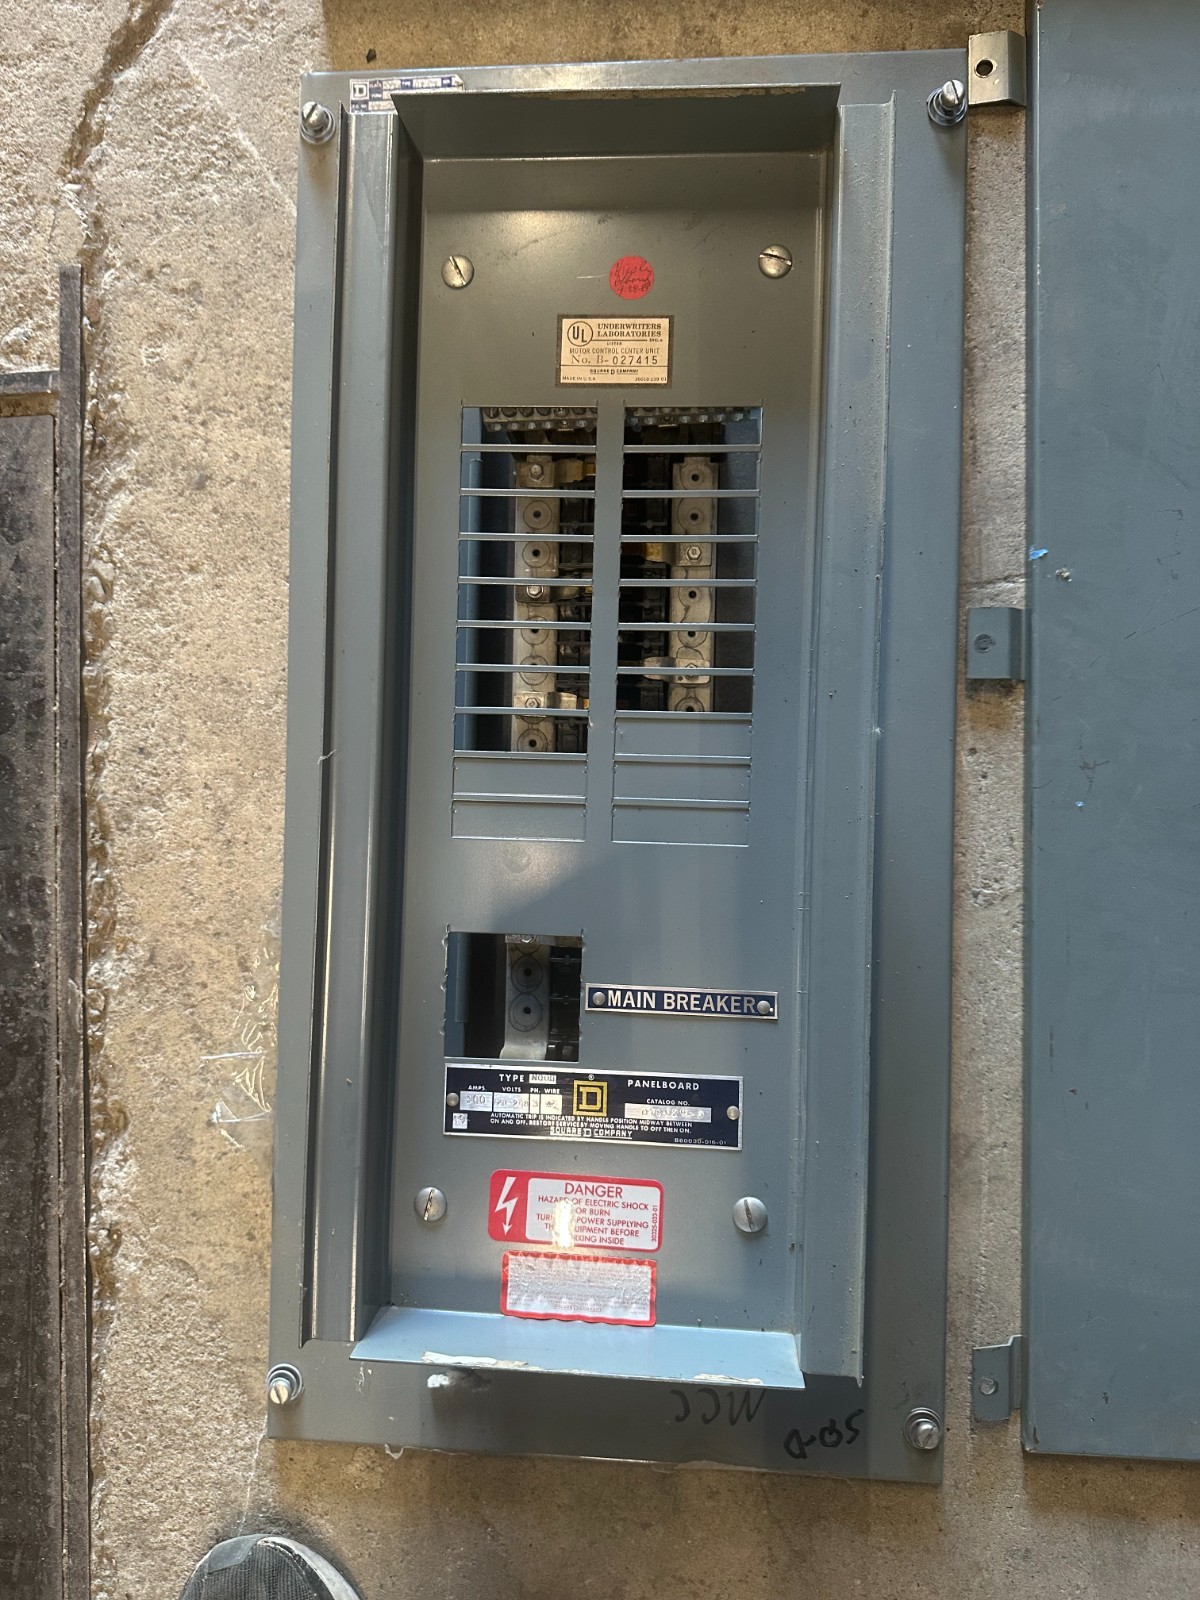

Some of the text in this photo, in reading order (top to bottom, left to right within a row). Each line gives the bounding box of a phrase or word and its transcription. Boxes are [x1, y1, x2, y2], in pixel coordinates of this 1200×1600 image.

[572, 326, 588, 342] UL
[571, 355, 591, 364] No.
[608, 990, 756, 1014] MAIN BREAKER
[499, 1074, 525, 1082] TYPE
[627, 1079, 700, 1091] PANELBOARD
[550, 1127, 632, 1138] SQUARE D COMPANY
[564, 1182, 623, 1198] DANGER
[586, 1199, 620, 1208] ELECTRIC
[622, 1202, 649, 1210] SHOCK
[576, 1216, 605, 1225] POWER
[607, 1218, 649, 1229] SUPPLYING
[610, 1228, 640, 1237] BEFORE
[599, 1237, 624, 1245] INSIDE
